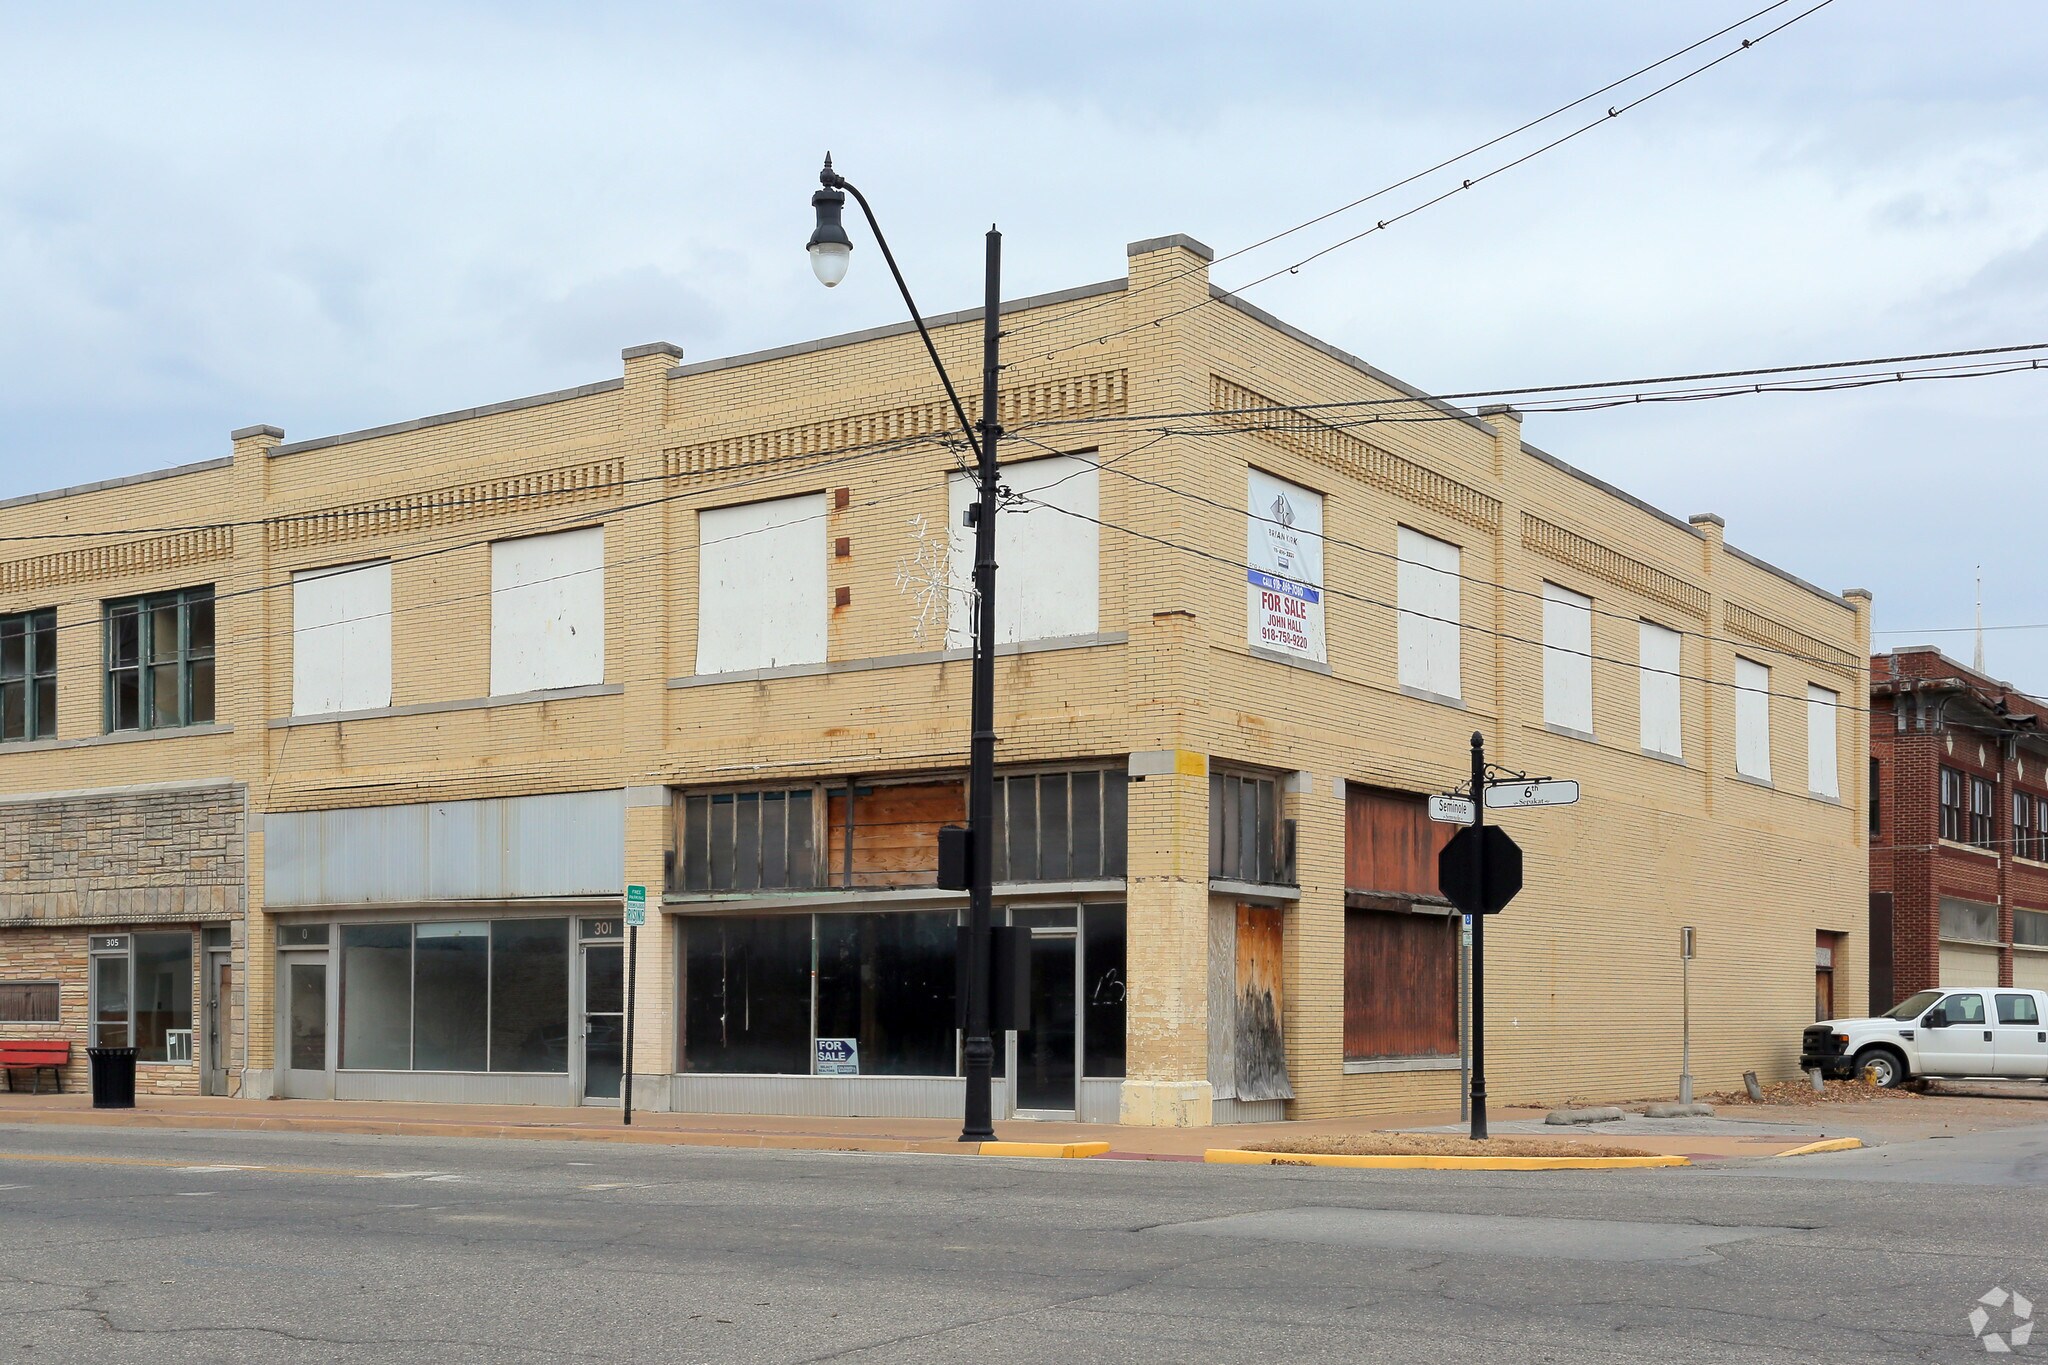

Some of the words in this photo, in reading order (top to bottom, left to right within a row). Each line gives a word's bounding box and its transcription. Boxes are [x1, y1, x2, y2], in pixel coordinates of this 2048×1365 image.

[1261, 591, 1282, 613] FOR
[1284, 596, 1307, 620] SALE
[1267, 614, 1286, 629] JOHN
[1287, 618, 1303, 633] HALL
[1261, 627, 1308, 649] 918-758-9220
[1524, 785, 1539, 798] 6th
[1438, 799, 1467, 814] Seminole
[594, 922, 612, 935] 301
[106, 939, 119, 947] 305
[819, 1041, 842, 1050] FOR
[818, 1051, 846, 1061] SALE
